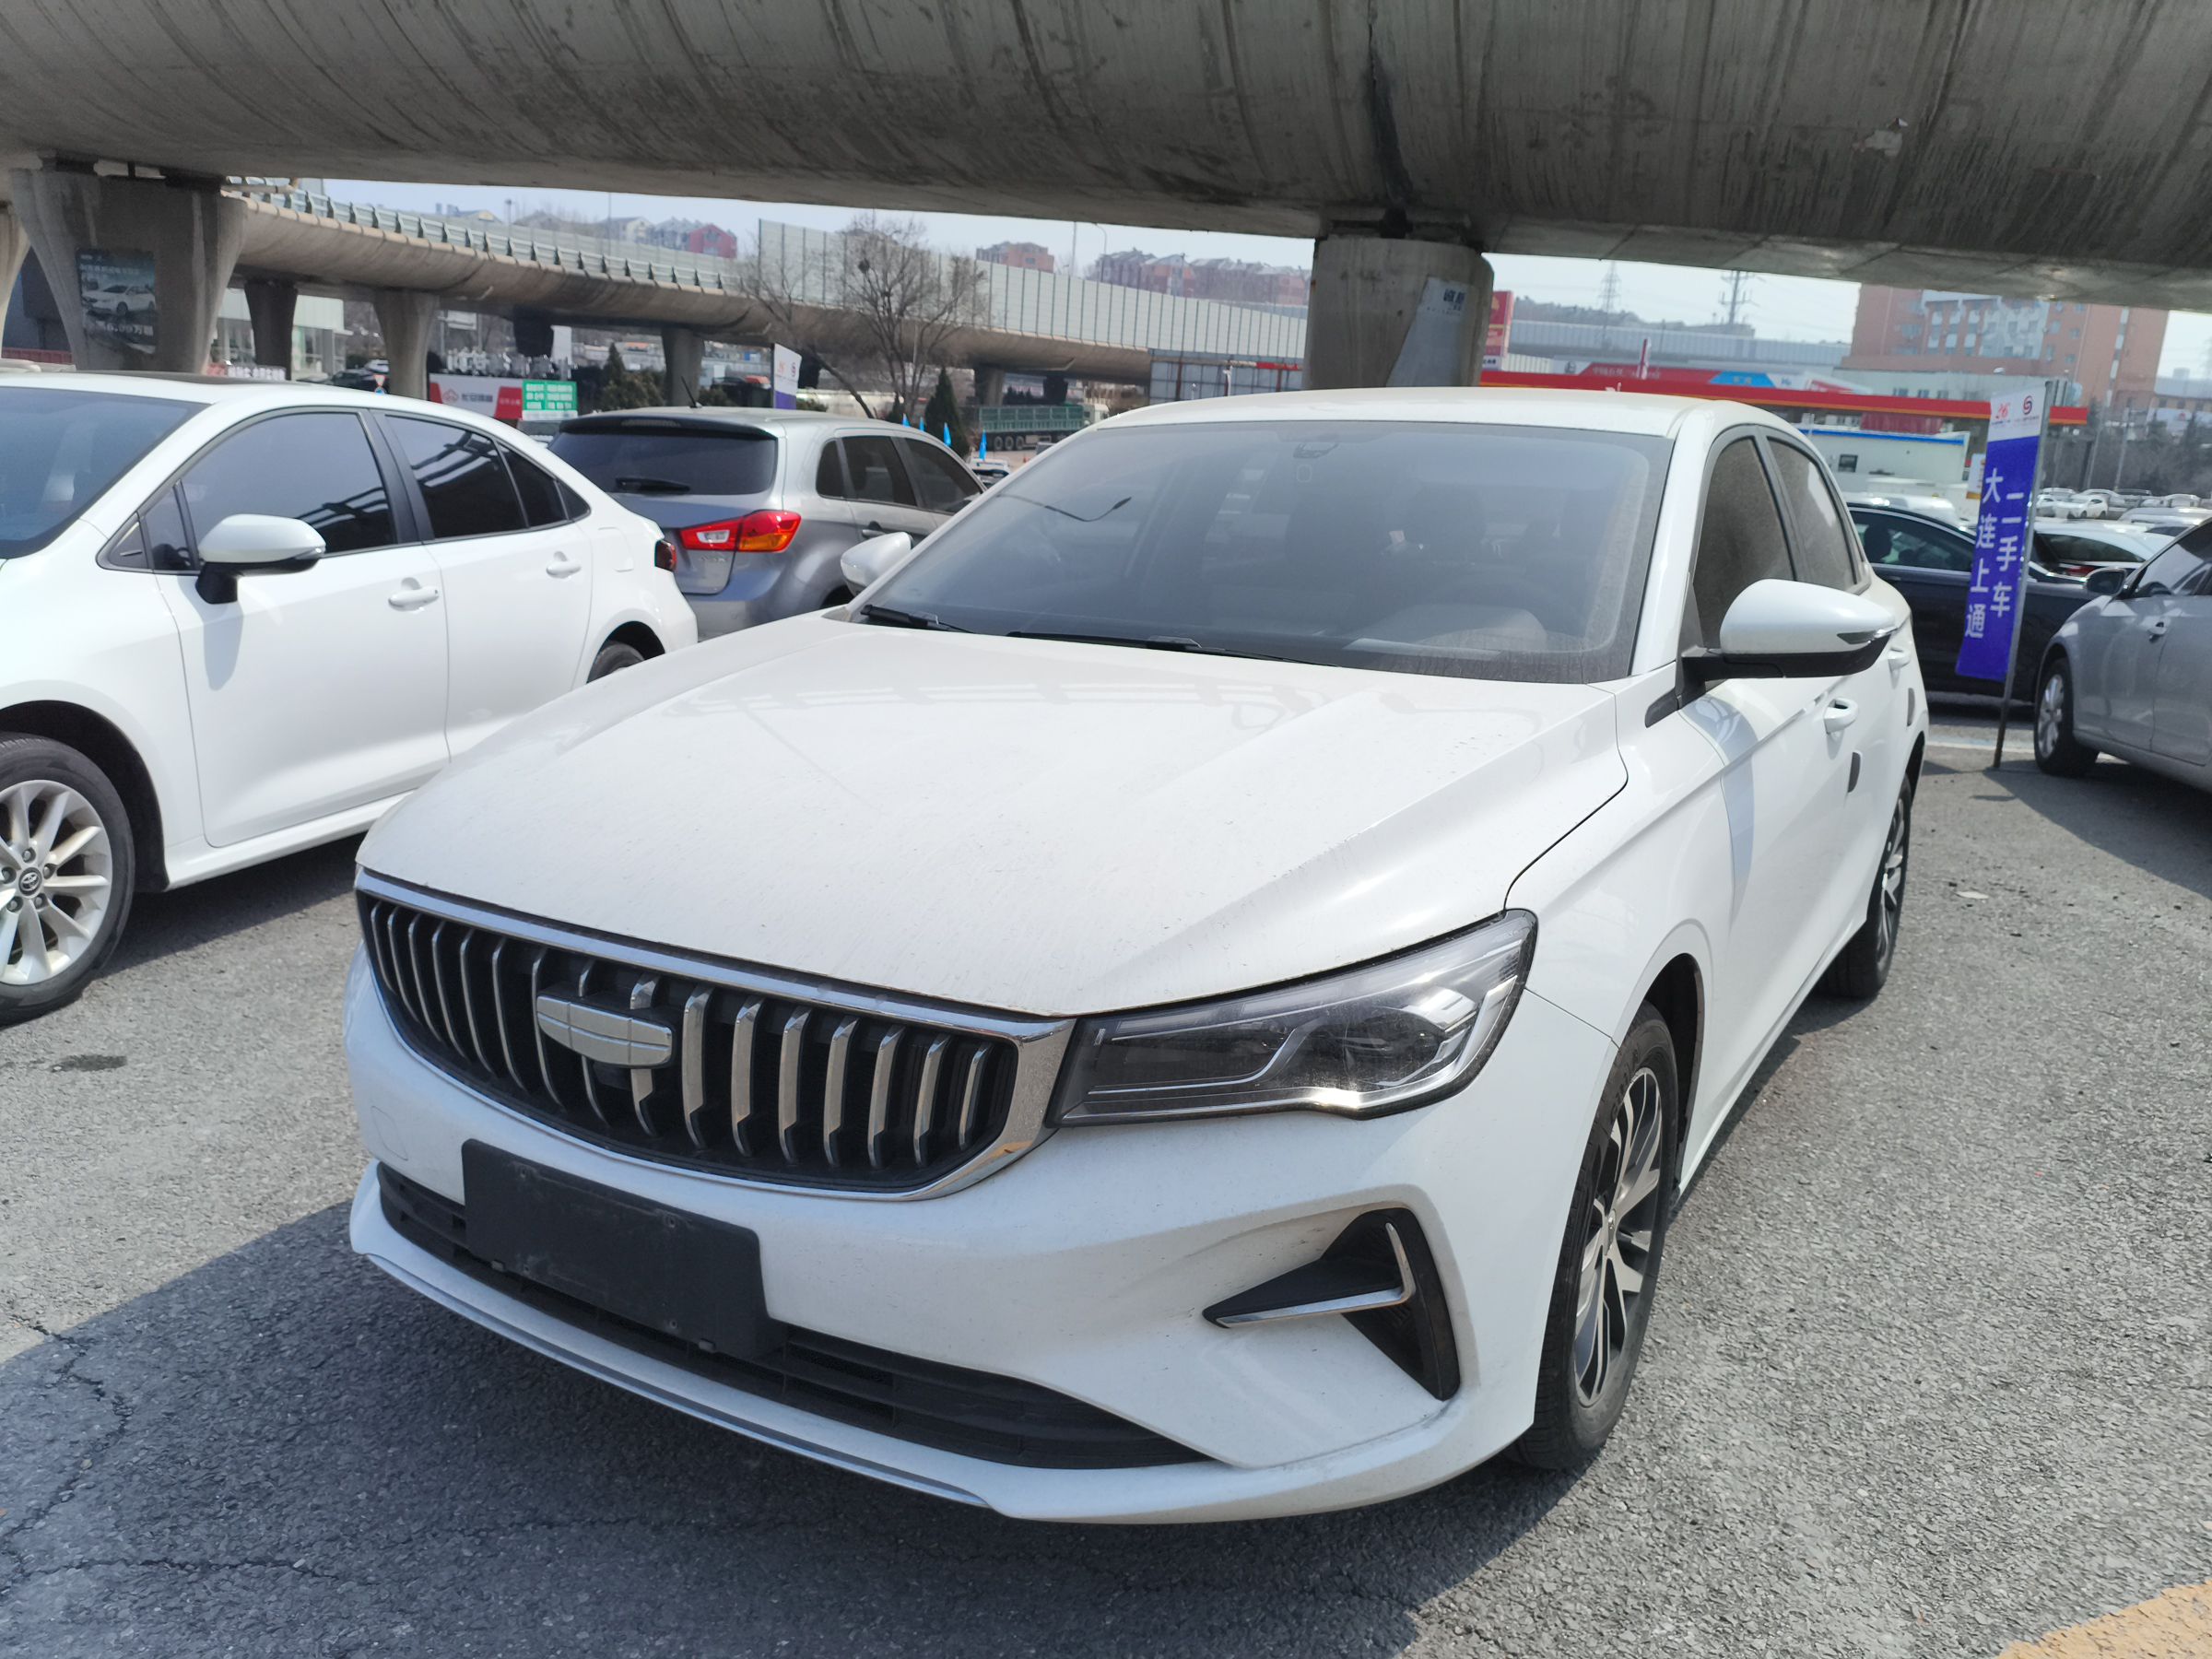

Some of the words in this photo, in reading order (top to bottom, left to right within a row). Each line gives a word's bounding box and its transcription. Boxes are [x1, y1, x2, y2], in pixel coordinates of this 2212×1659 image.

[1965, 467, 2004, 639] 大连上通
[1990, 492, 2024, 618] 二手车
